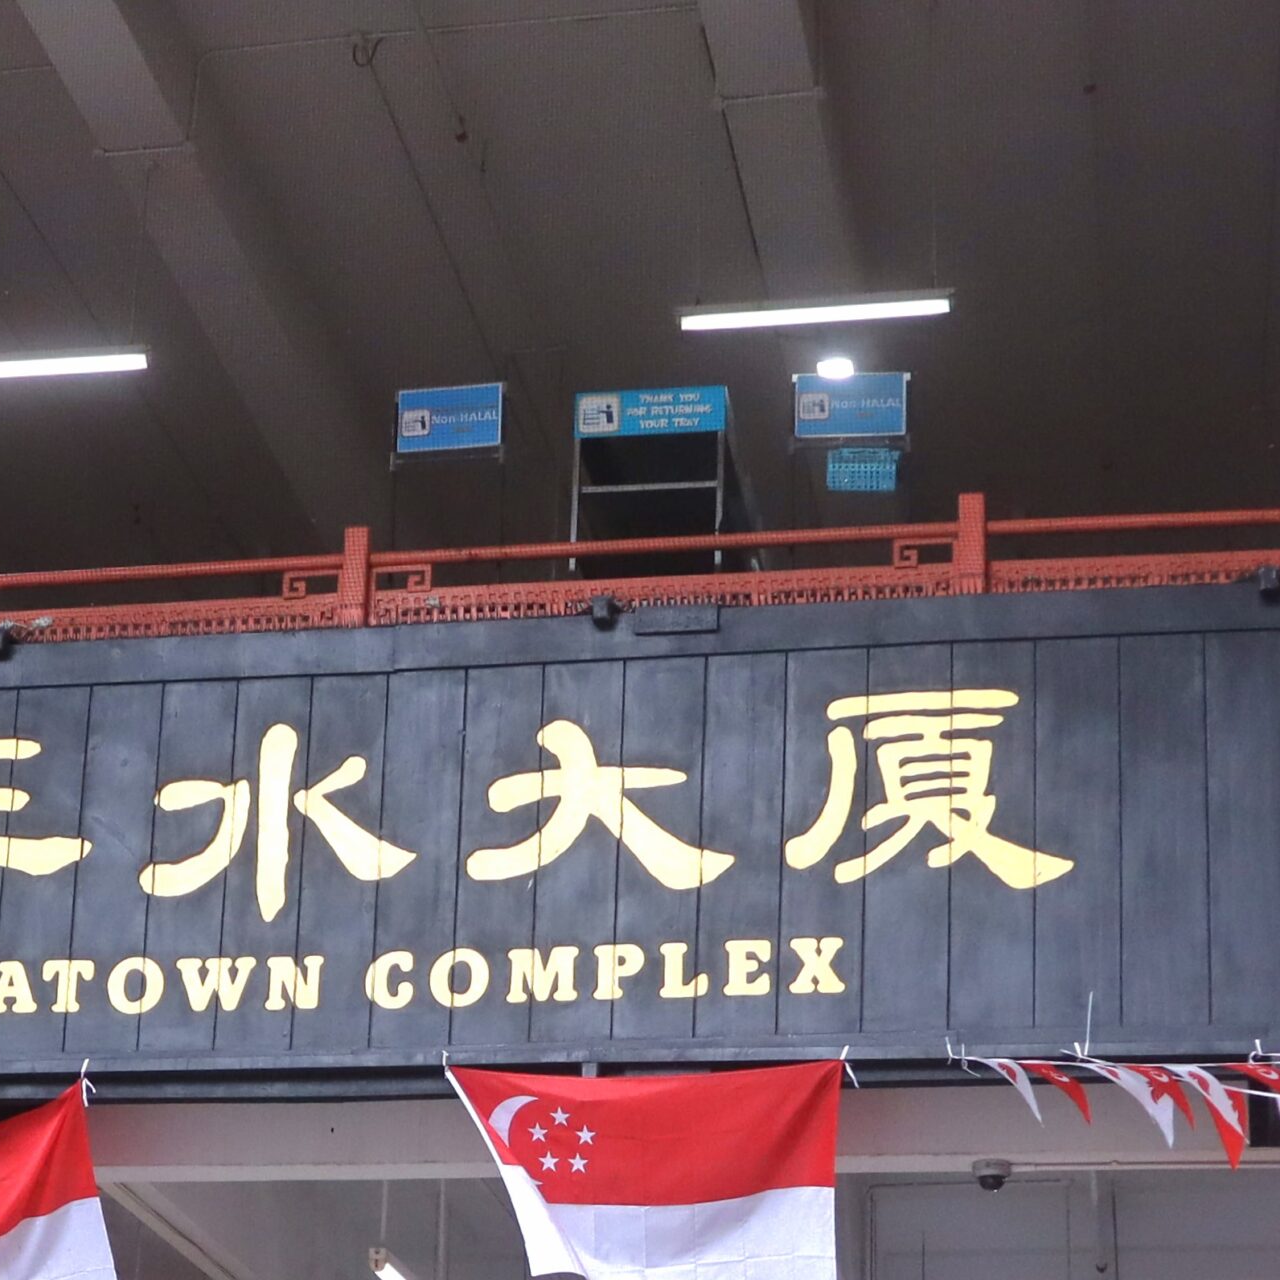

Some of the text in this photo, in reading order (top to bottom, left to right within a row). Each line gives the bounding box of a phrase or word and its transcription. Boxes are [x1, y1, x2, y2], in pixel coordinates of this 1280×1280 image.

[680, 393, 700, 401] YOU
[640, 417, 700, 429] YOUR TRAY
[364, 935, 846, 1010] COMPLEX
